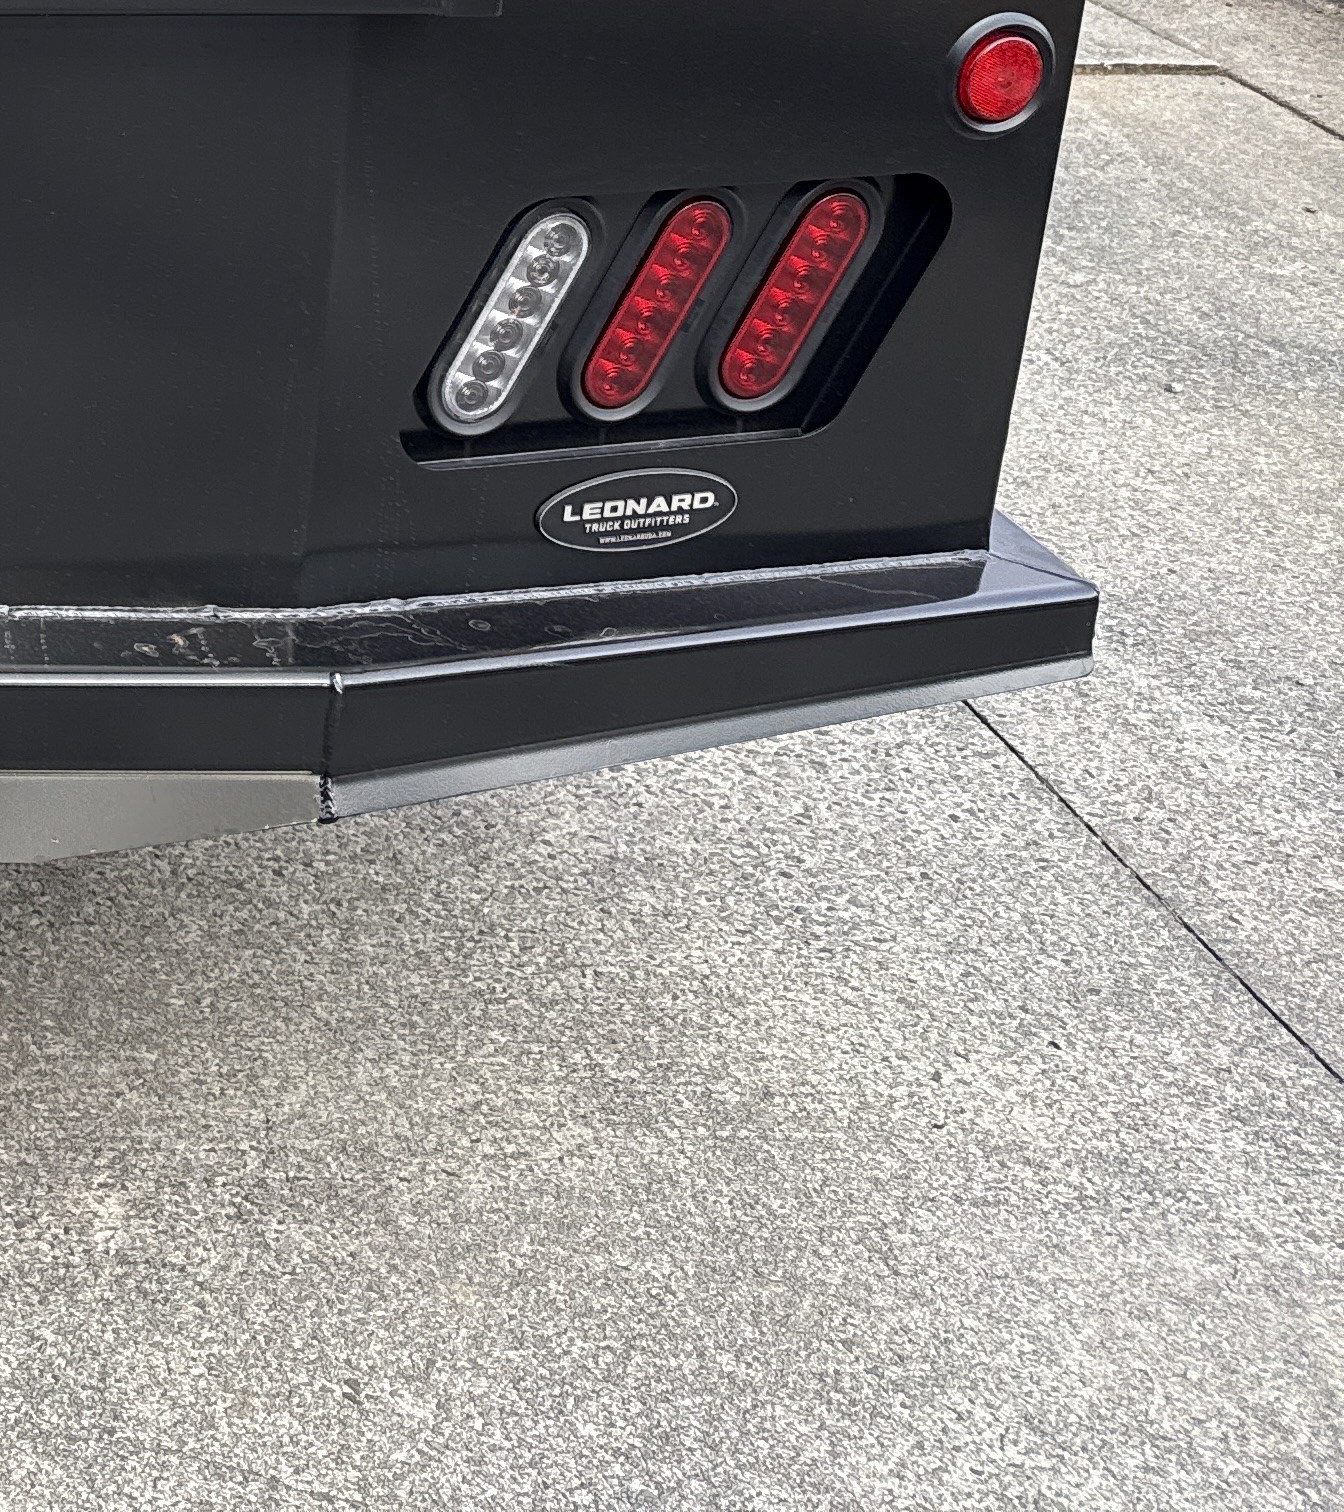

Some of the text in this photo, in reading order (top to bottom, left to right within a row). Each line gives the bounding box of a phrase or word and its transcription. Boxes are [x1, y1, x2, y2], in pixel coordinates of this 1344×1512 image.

[562, 490, 716, 522] LEONARD
[584, 514, 690, 534] TRUCK OUTFITTERS
